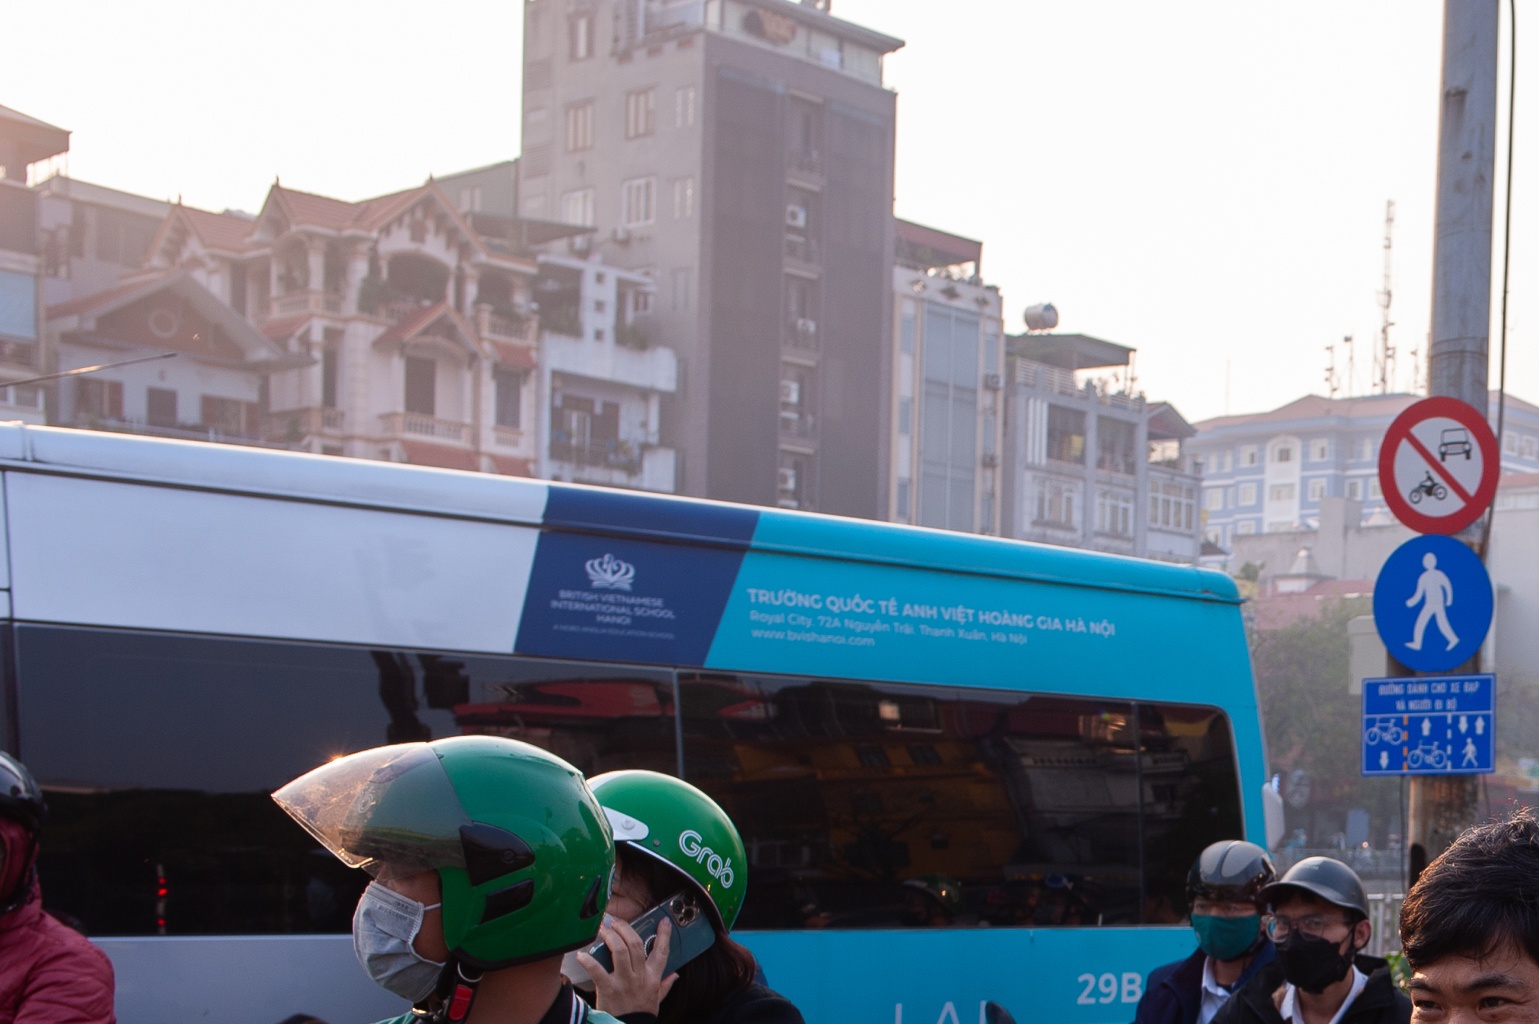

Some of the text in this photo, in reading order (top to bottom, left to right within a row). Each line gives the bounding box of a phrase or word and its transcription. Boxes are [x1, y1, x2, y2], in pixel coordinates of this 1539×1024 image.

[551, 600, 675, 619] INTERNATIONAL SCHOOL
[559, 590, 663, 607] BRITISH VIETNAMESE
[746, 587, 823, 610] TRƯỜNG
[825, 592, 875, 614] QUỐC
[902, 603, 938, 620] ANH
[940, 604, 975, 625] VIỆT
[977, 609, 1034, 629] HOÀNG
[1036, 615, 1063, 631] GIA
[1065, 617, 1087, 633] HÀ
[1089, 618, 1116, 639] NỘI
[678, 828, 735, 890] Grab
[1076, 971, 1143, 1006] 29B
